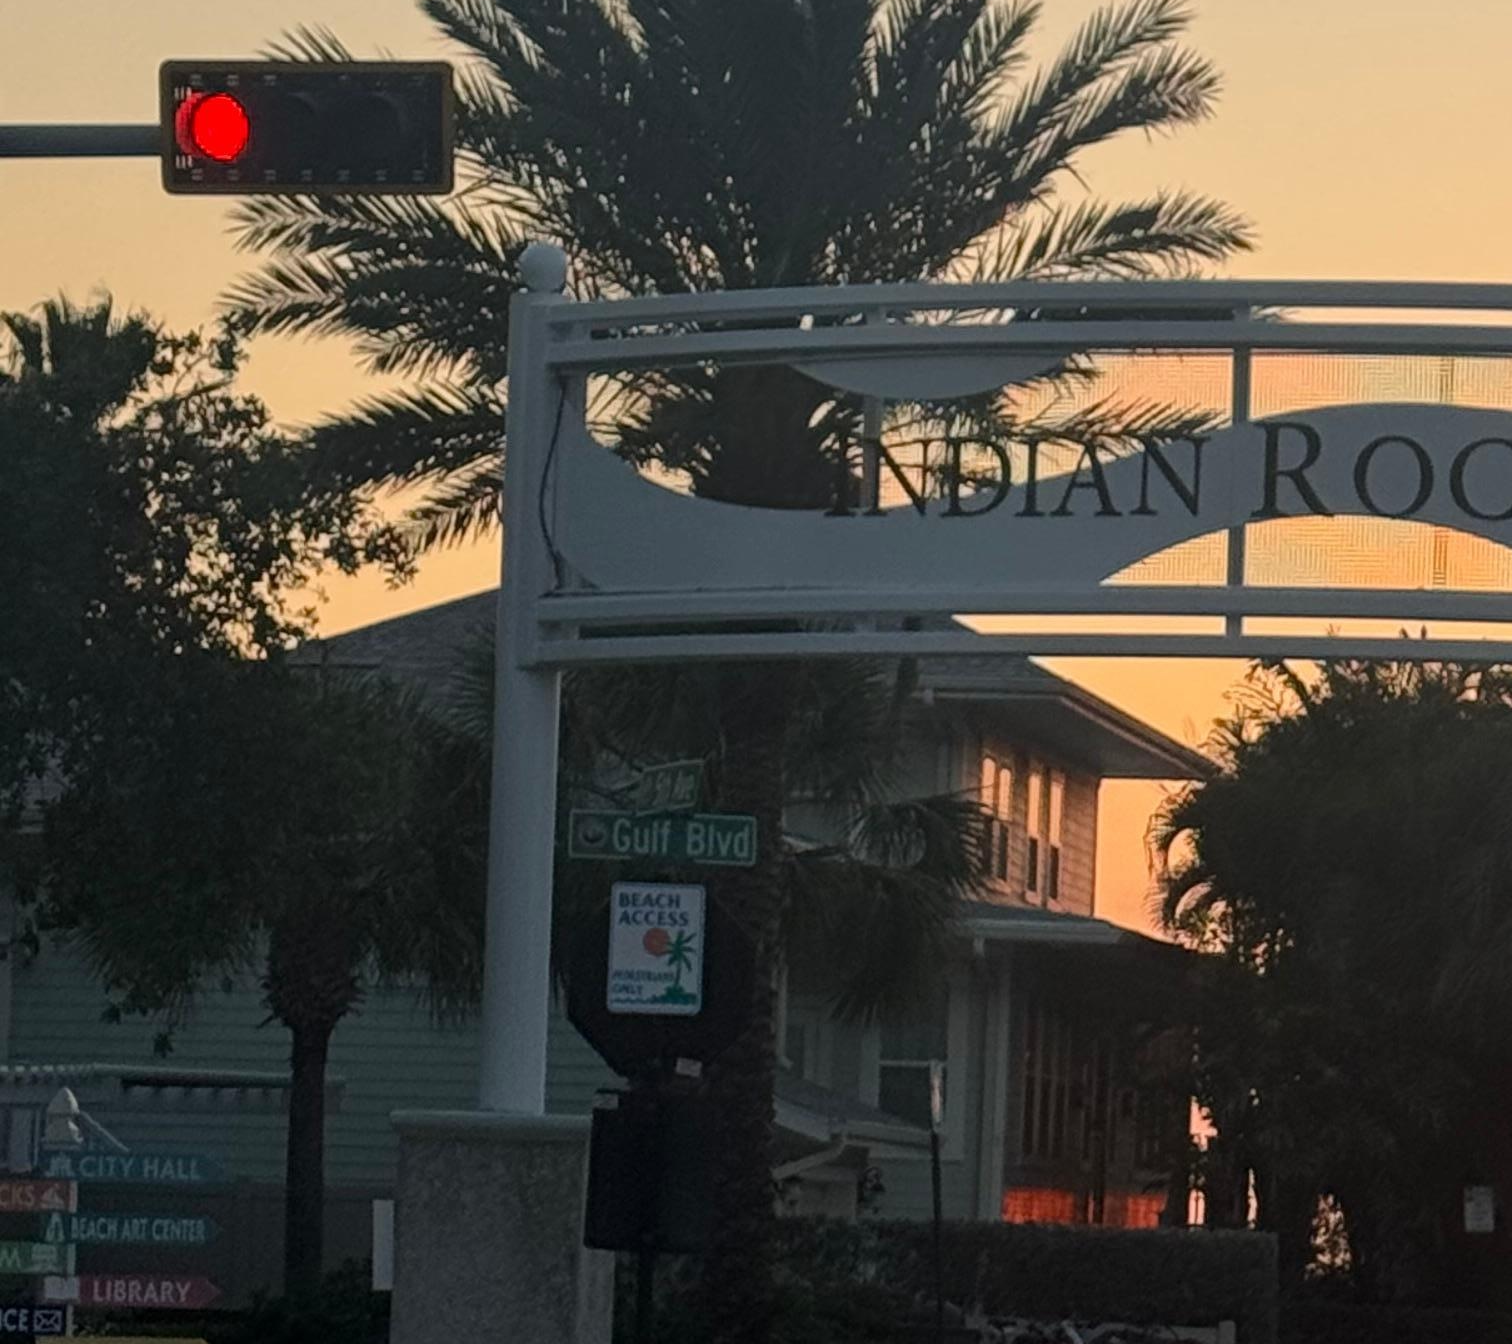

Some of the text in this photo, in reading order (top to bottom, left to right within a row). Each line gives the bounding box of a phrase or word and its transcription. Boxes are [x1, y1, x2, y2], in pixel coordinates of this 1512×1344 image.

[825, 434, 1211, 517] INDIAN
[612, 817, 749, 858] Gulf Blvd
[618, 892, 681, 909] BEACH
[618, 910, 689, 927] ACCESS
[79, 1155, 200, 1180] CITY HALL
[70, 1215, 206, 1243] BEACH ART CENTER
[92, 1279, 192, 1304] LIBRARY
